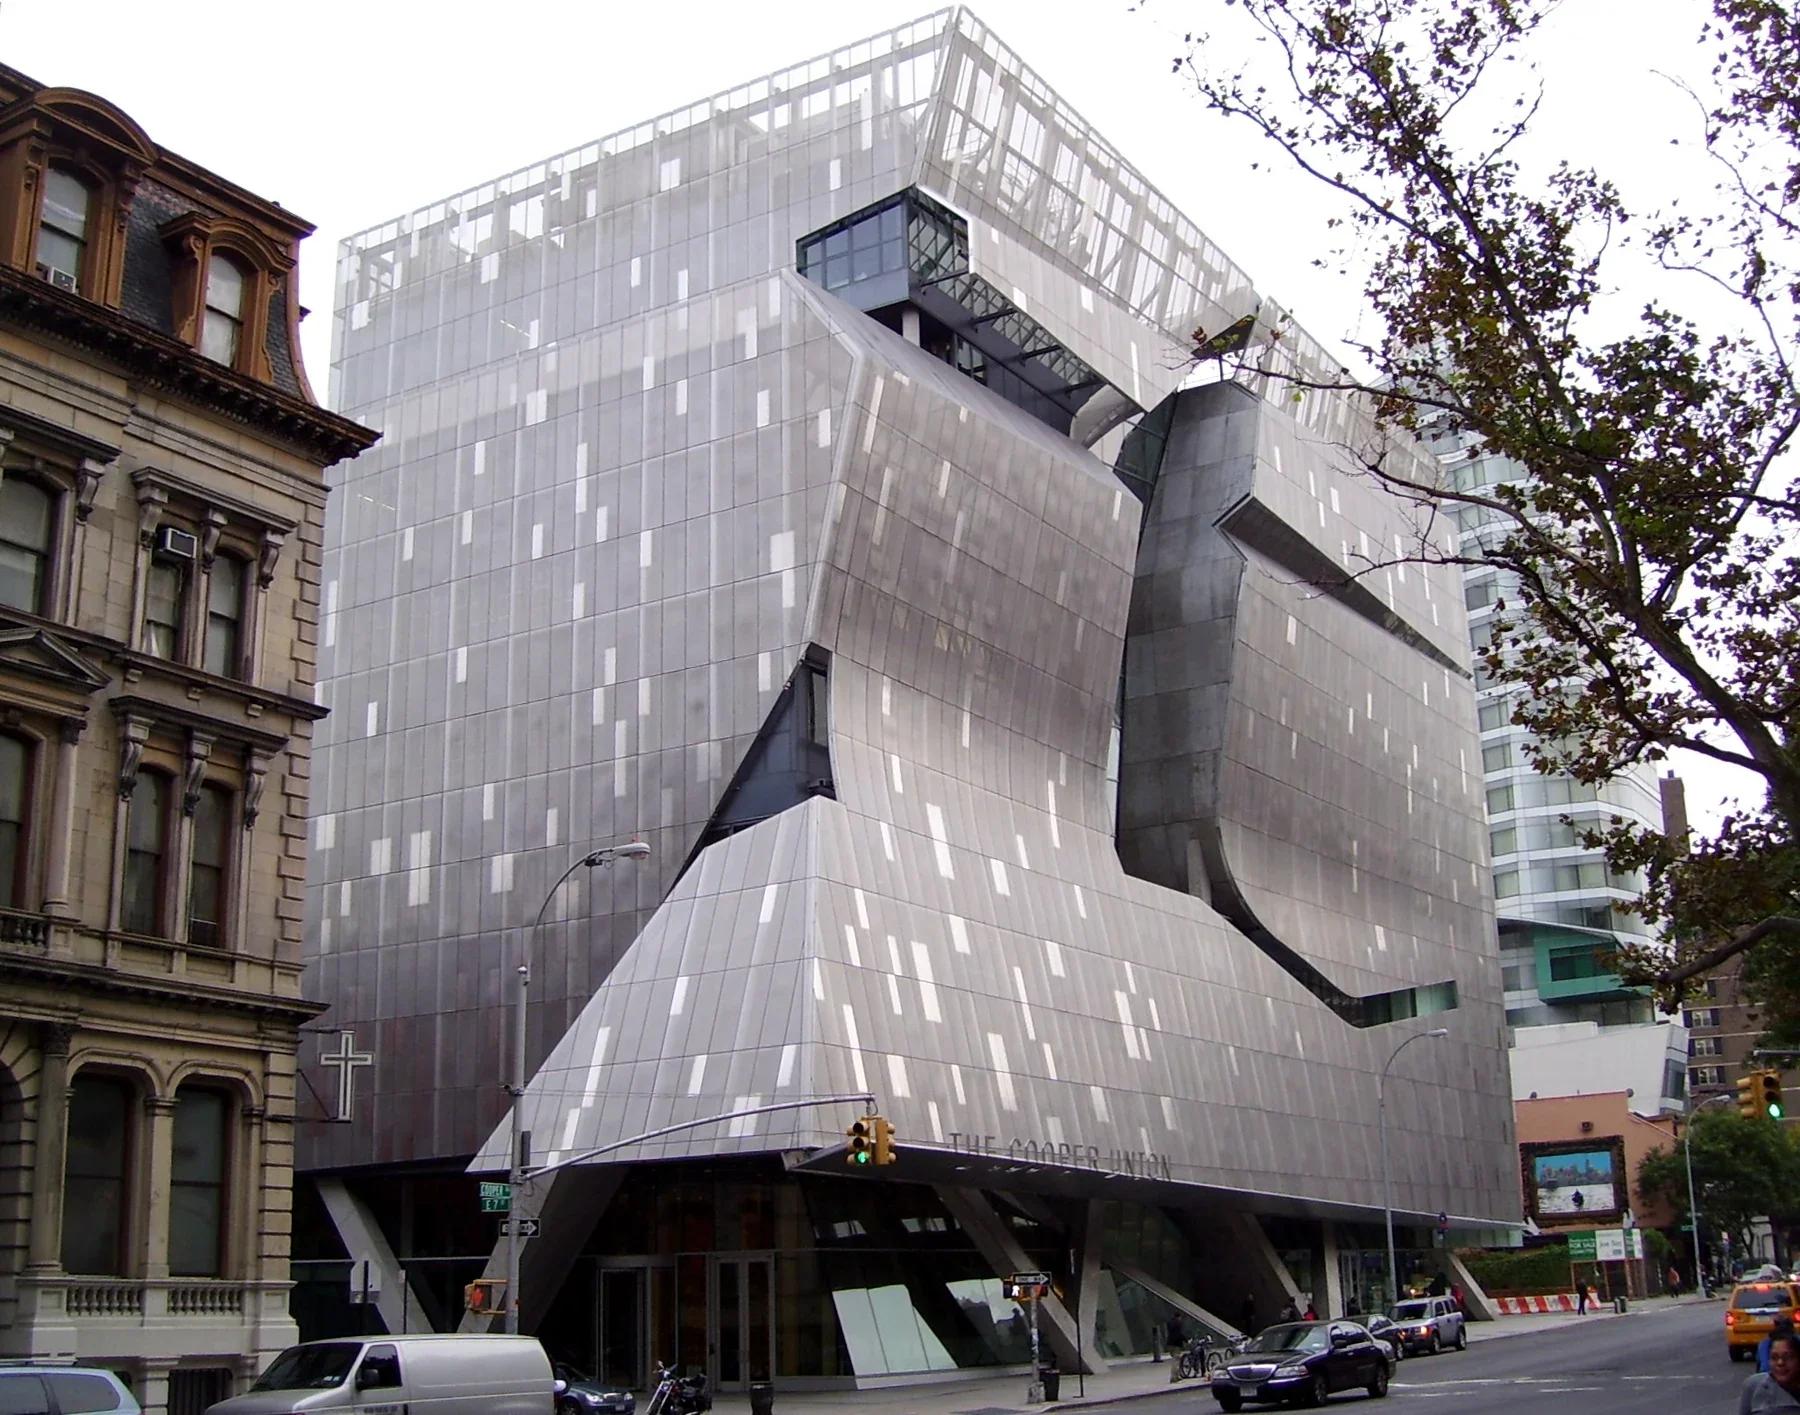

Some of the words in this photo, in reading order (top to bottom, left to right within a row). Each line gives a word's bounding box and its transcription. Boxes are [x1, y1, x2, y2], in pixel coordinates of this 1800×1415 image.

[948, 1132, 996, 1156] THE
[1008, 1137, 1100, 1171] COOPER
[1109, 1149, 1172, 1181] UNION
[480, 1184, 504, 1196] COOPER
[486, 1200, 491, 1210] E
[493, 1200, 499, 1210] 7
